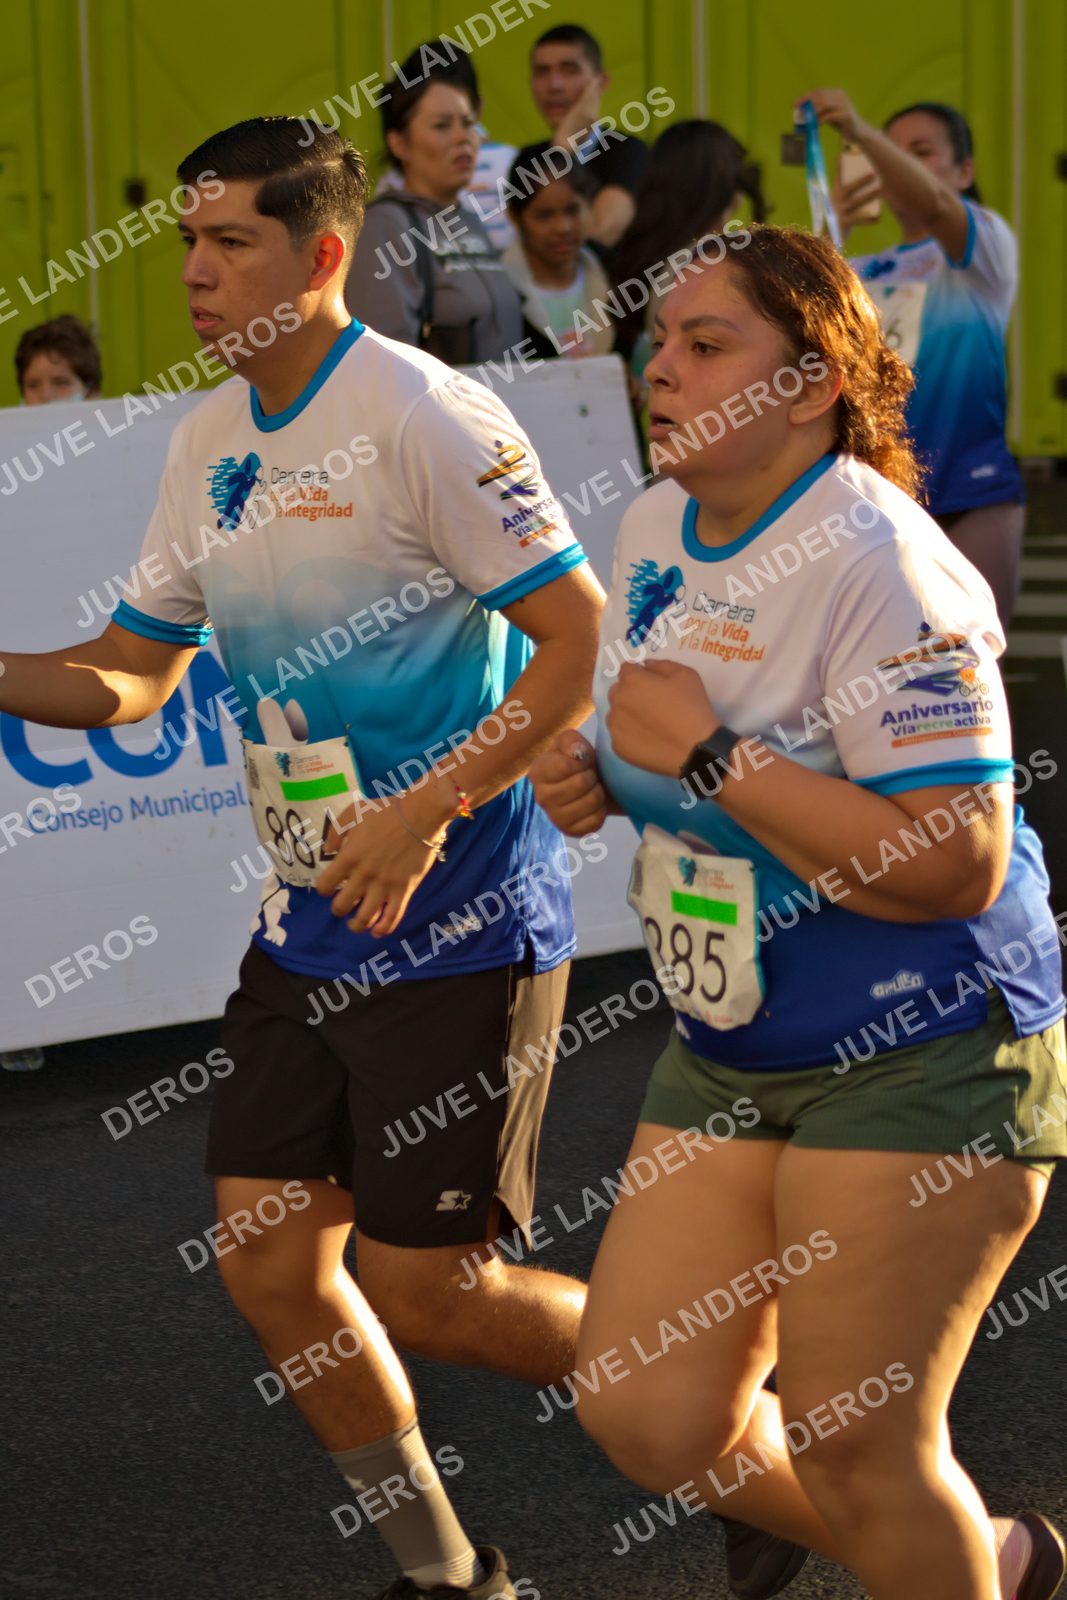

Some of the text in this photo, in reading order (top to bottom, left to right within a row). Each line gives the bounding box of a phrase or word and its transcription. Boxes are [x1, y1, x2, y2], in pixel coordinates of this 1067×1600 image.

[722, 621, 749, 643] Vida
[880, 697, 993, 727] Aniversario
[28, 781, 247, 834] Consejo Municipal
